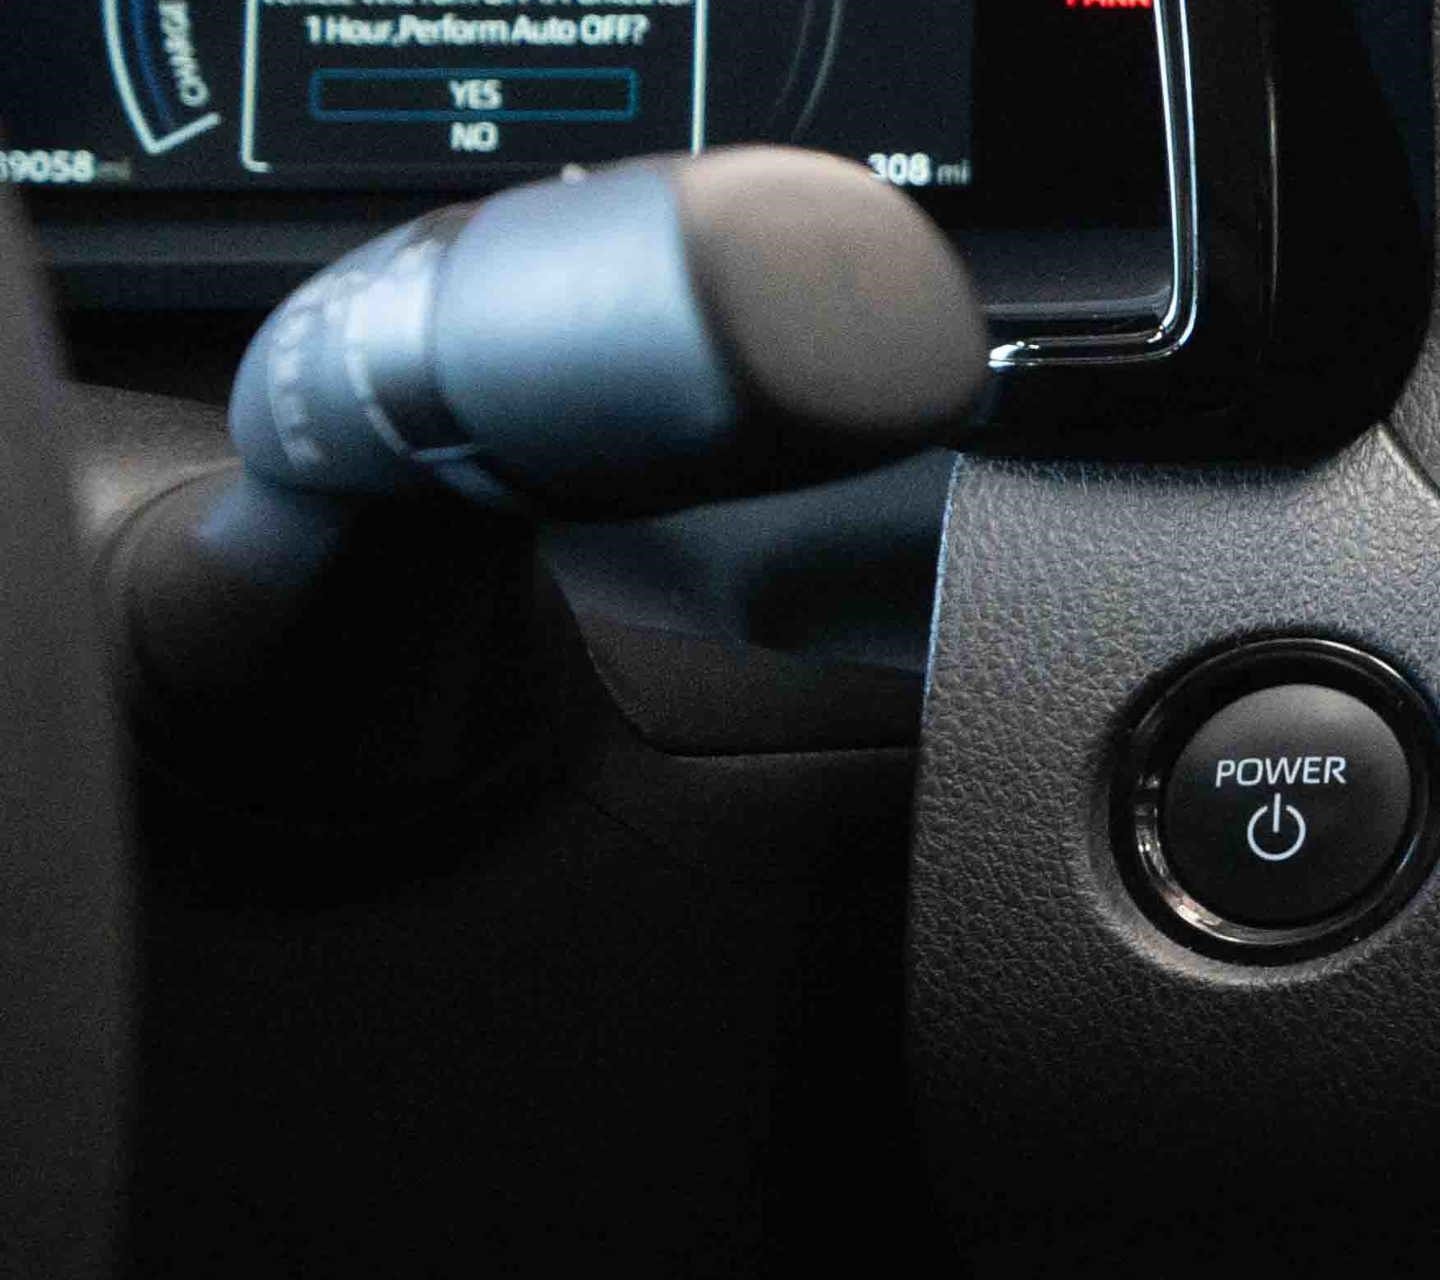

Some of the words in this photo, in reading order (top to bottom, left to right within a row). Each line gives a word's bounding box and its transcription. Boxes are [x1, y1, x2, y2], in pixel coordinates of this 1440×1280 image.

[307, 14, 322, 46] 1
[511, 14, 577, 46] Auto
[579, 14, 650, 46] OFF?
[449, 78, 503, 111] YES
[450, 121, 500, 152] NO
[936, 159, 971, 186] mi
[1214, 755, 1348, 788] POWER
